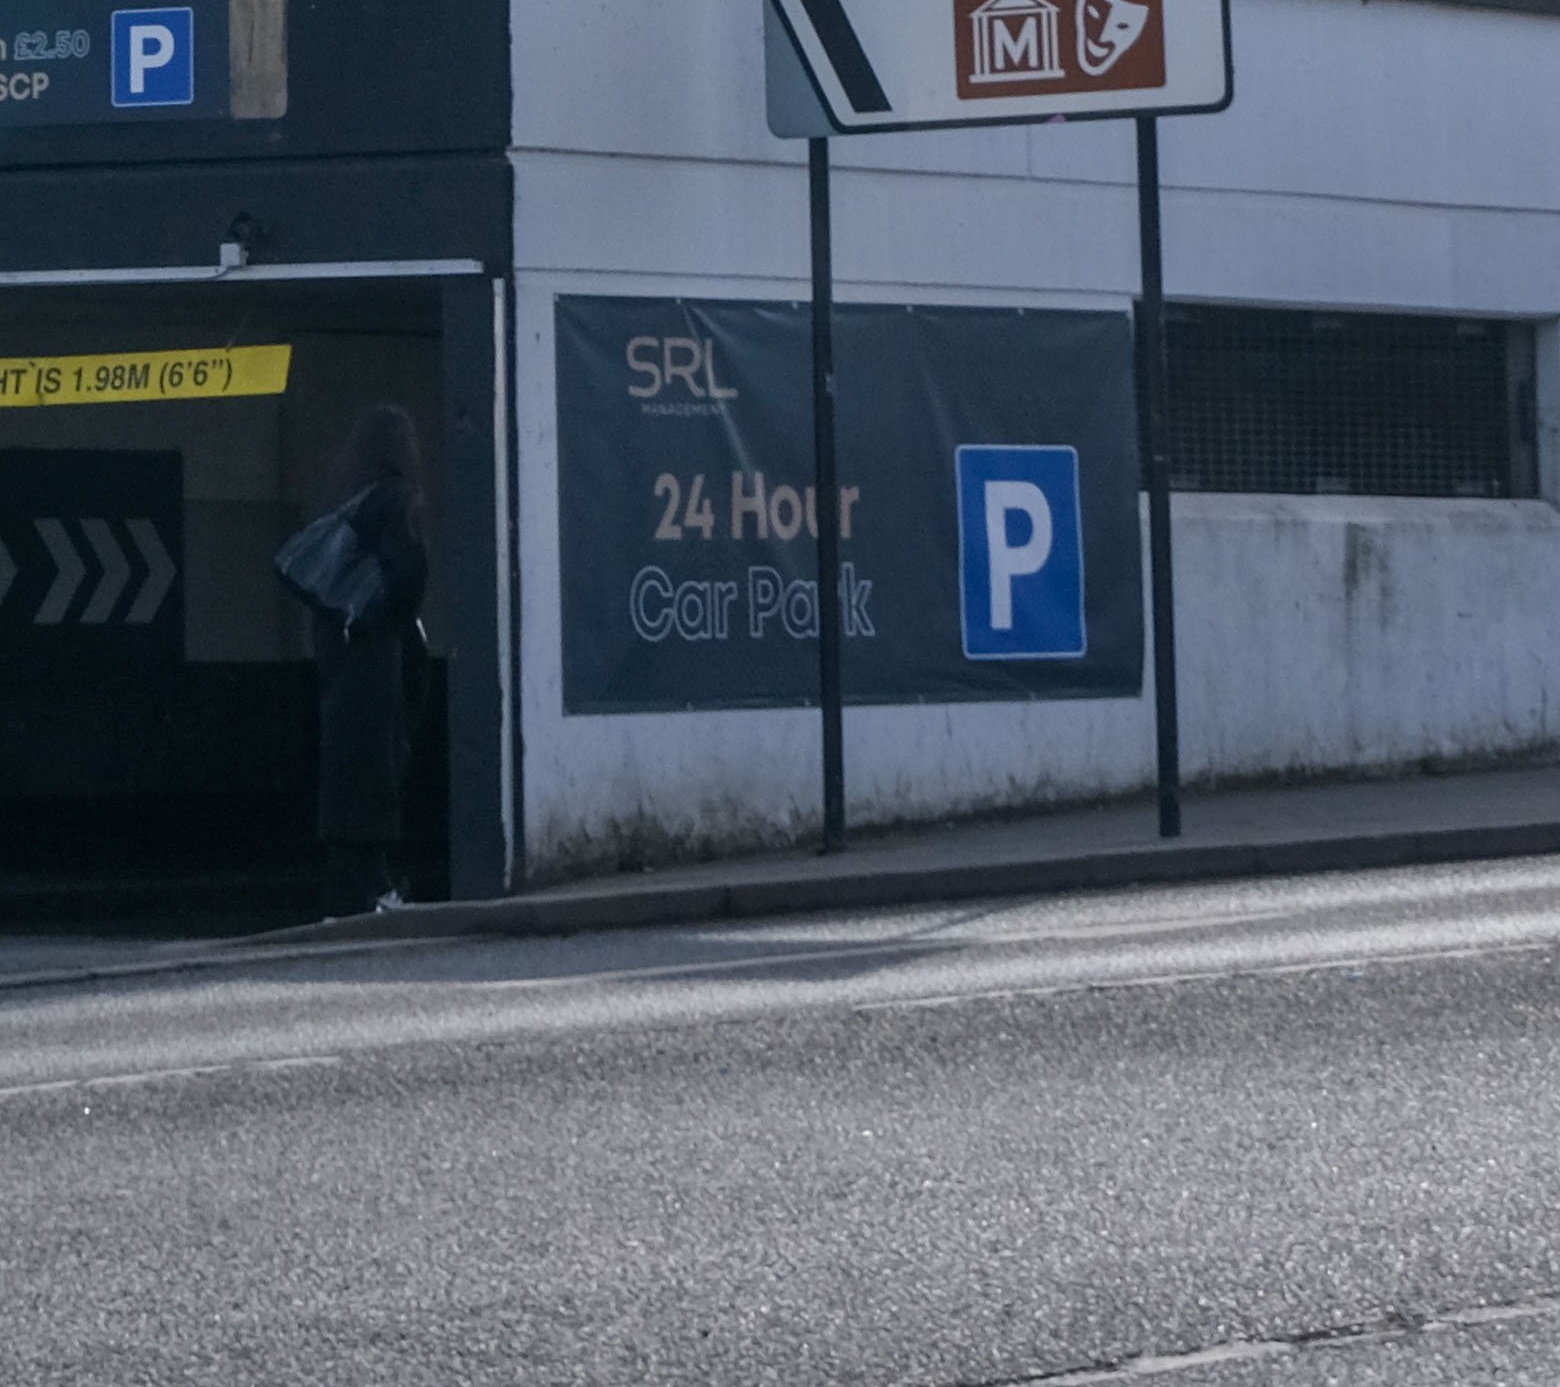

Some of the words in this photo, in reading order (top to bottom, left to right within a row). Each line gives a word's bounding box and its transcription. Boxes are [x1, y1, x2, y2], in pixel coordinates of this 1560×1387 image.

[13, 30, 91, 61] £2.50
[129, 24, 175, 94] P
[35, 365, 62, 396] IS
[73, 363, 150, 393] 1.98M
[626, 336, 738, 400] SRL
[654, 472, 715, 541] 24
[983, 480, 1053, 631] P
[630, 565, 739, 643] Car
[748, 560, 877, 639] Pak
